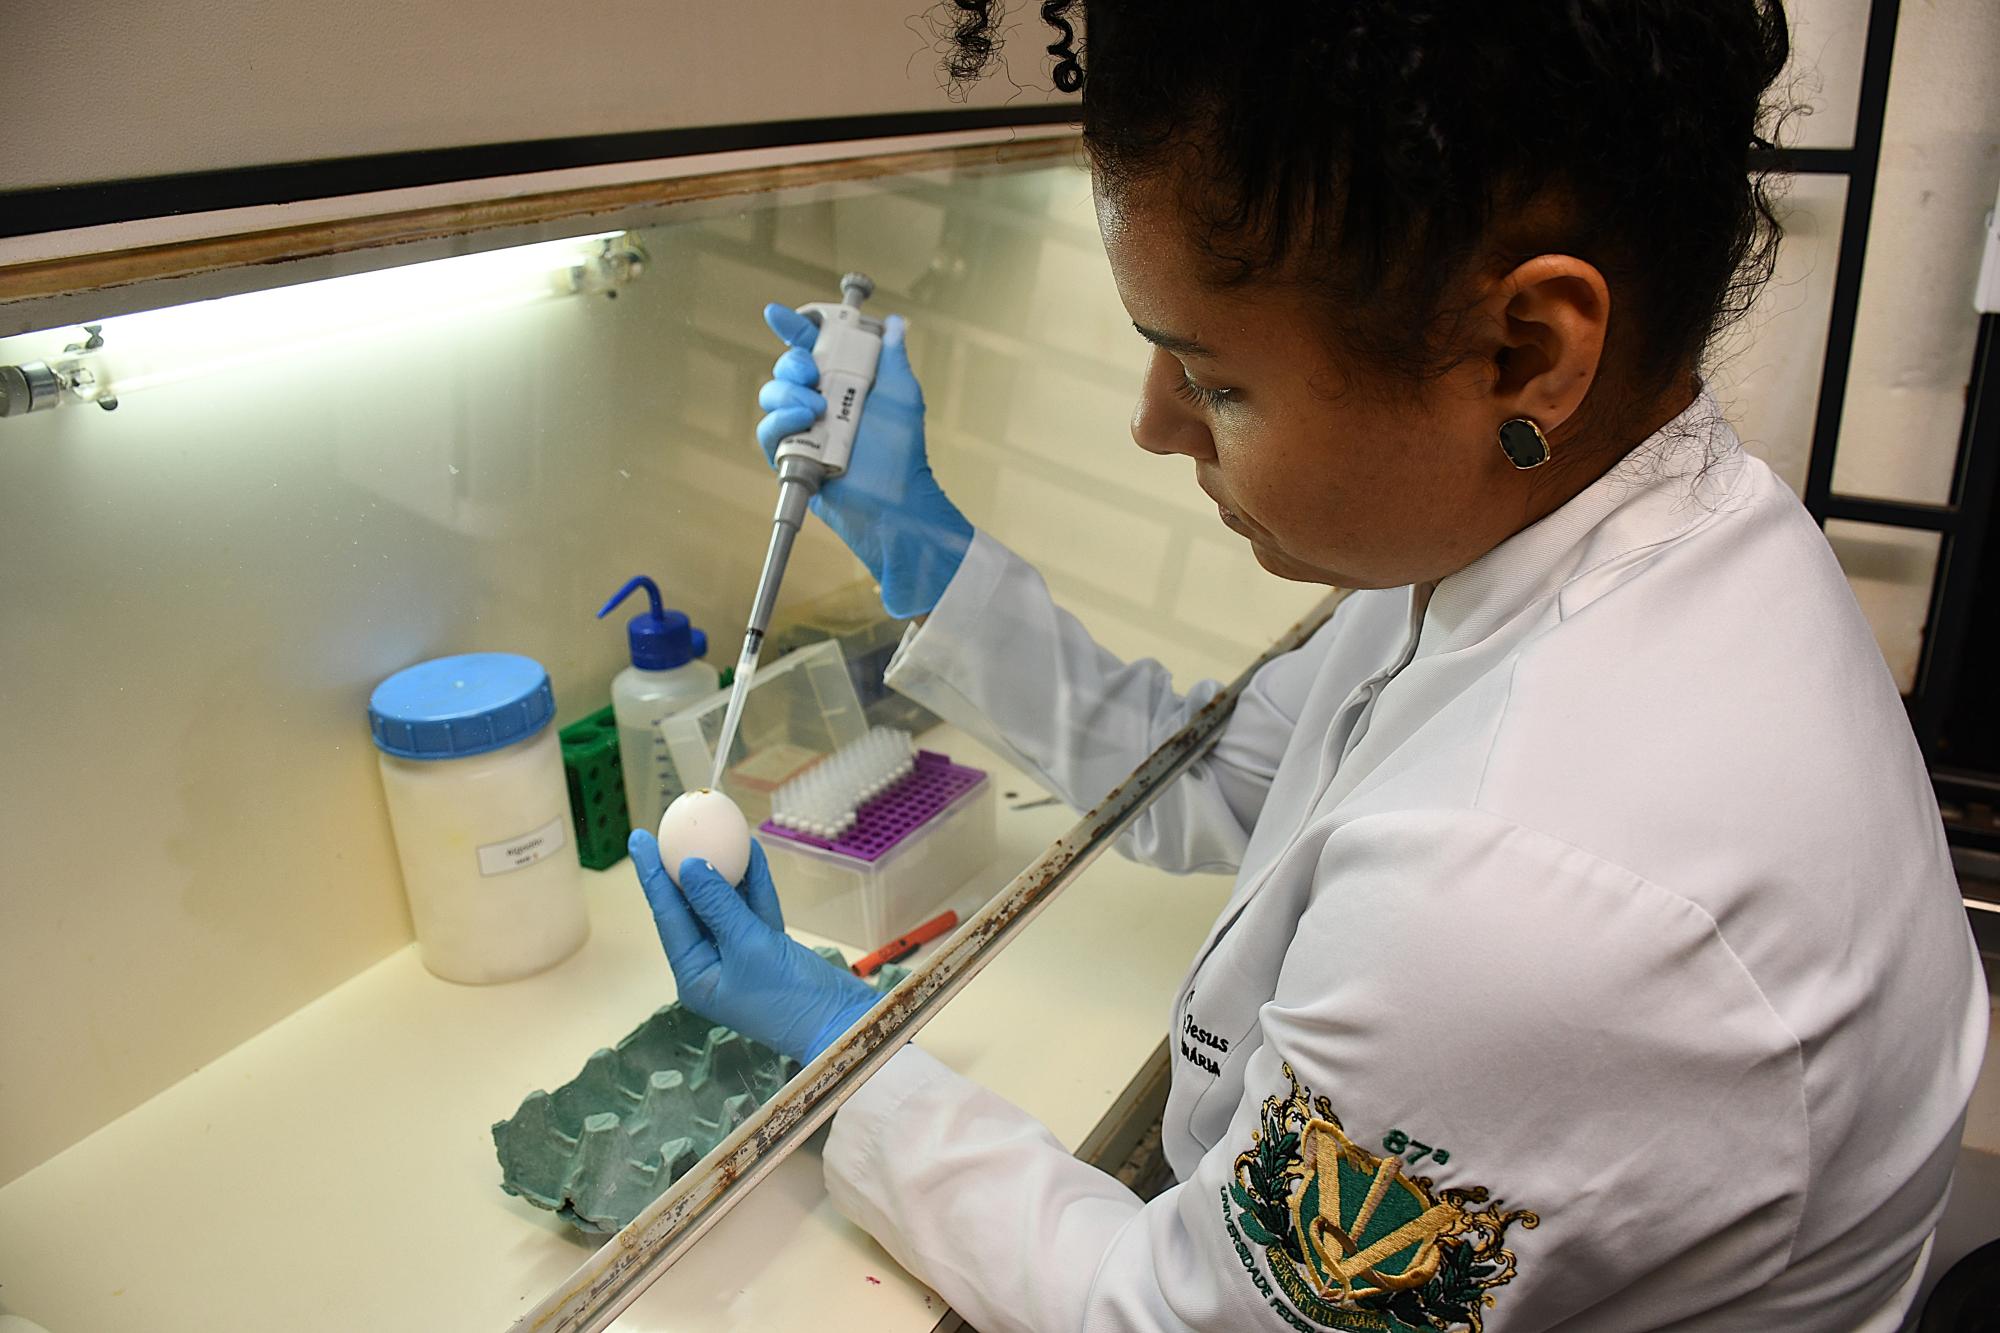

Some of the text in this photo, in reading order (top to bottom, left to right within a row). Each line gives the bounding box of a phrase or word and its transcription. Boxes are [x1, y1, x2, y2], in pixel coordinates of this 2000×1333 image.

[837, 387, 857, 422] Jetta
[1185, 1013, 1230, 1053] Jesus
[1220, 1185, 1274, 1299] UNIVERSIDADE
